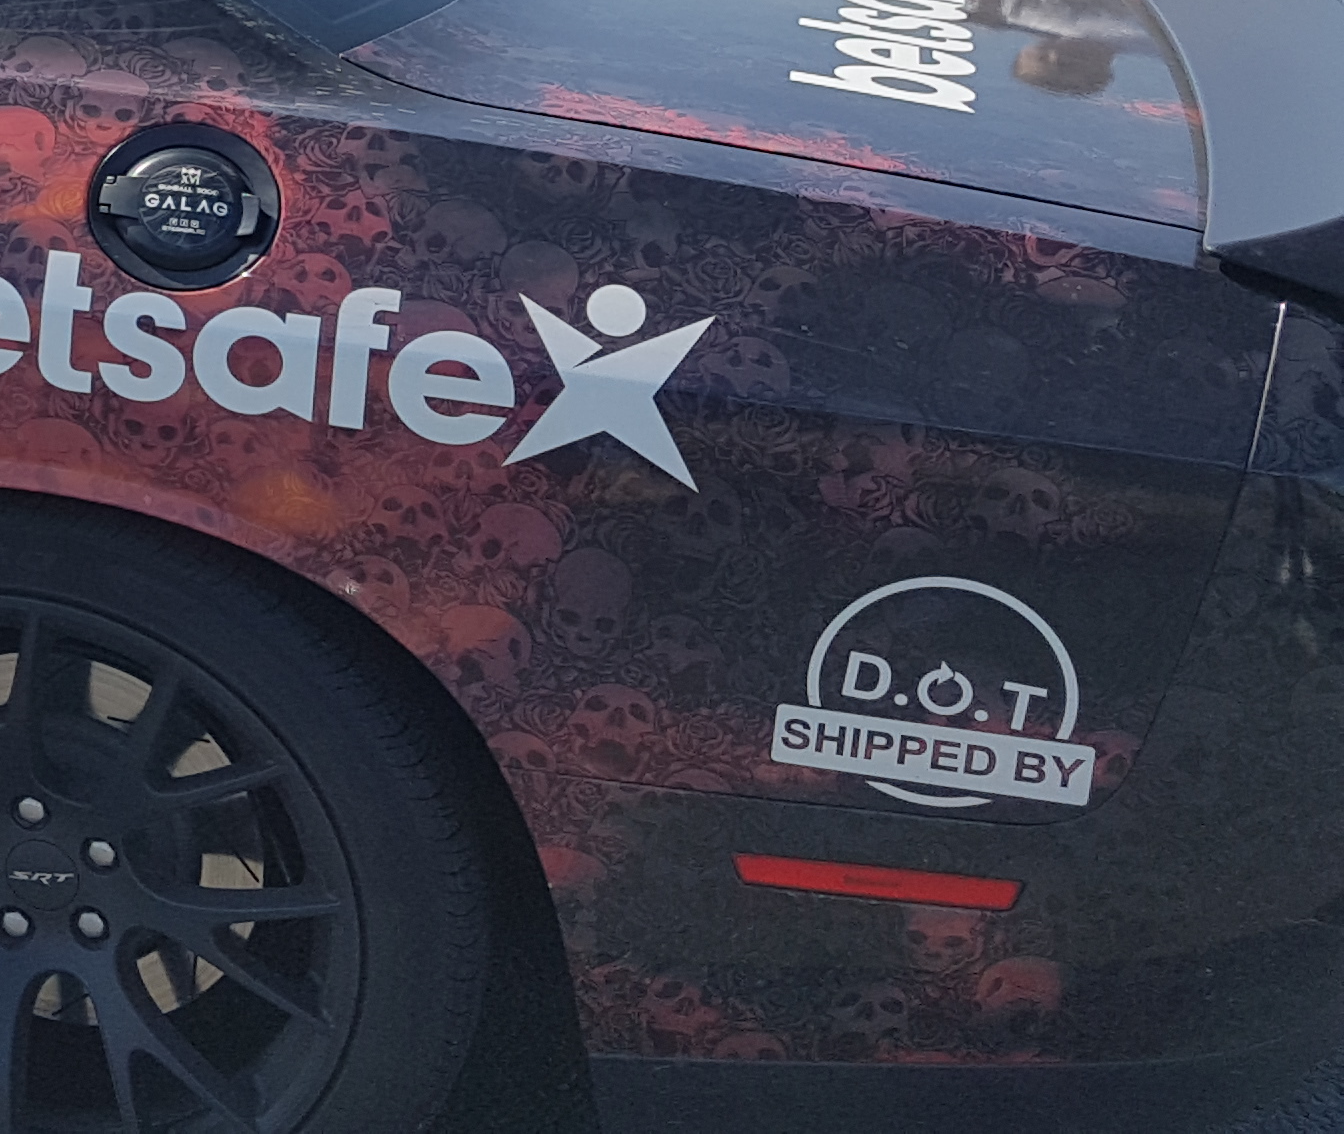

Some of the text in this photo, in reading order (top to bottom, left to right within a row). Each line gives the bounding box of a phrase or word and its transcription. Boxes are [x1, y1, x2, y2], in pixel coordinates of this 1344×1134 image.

[144, 193, 228, 217] GALAG
[780, 718, 1086, 788] SHIPPED BY
[9, 870, 75, 887] SRT
